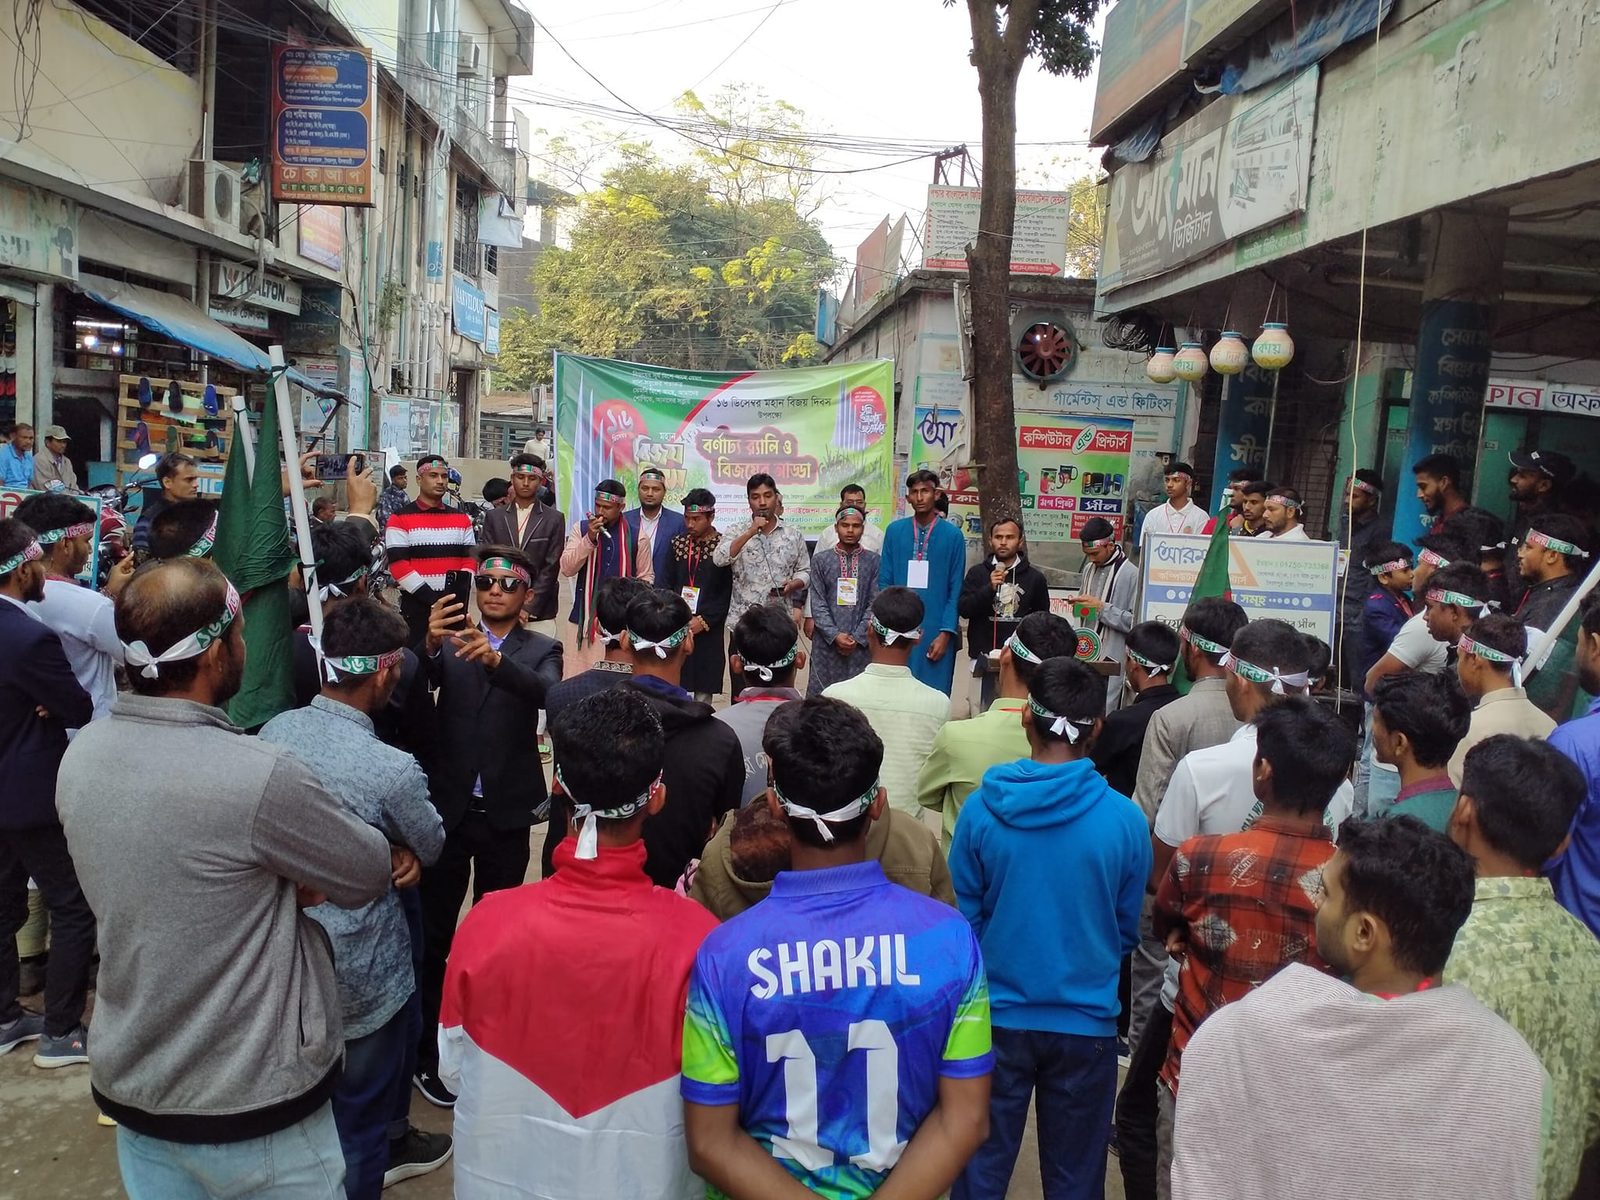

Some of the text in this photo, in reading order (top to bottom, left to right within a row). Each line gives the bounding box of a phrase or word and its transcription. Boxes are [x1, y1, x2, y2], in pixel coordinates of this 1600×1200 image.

[1172, 210, 1213, 253] ডিজিটাল
[716, 395, 832, 410] ১৬ ডিসেম্বর মহান বিজয় দিবস
[1106, 393, 1127, 408] এন্ড
[1133, 393, 1172, 412] ফিটিংস
[1551, 390, 1600, 412] অফ
[607, 409, 634, 434] ১৬
[660, 432, 676, 440] মহান
[702, 432, 741, 455] বর্ণাঢ্য
[783, 441, 793, 455] ও
[1023, 428, 1128, 451] কম্পিউটার এন্ড প্রিন্টার্স
[633, 434, 685, 465] বিজয়
[776, 462, 812, 480] আড্ডা
[1040, 496, 1073, 509] মগ প্রিন্ট
[1084, 499, 1118, 513] সীল
[1154, 541, 1209, 565] আরম
[1241, 594, 1267, 608] সমূহ
[197, 609, 230, 649] ১৬ই
[1298, 618, 1316, 629] সীল
[343, 656, 379, 674] ১৬ই
[747, 934, 921, 1000] SHAKIL
[765, 1019, 909, 1172] 11
